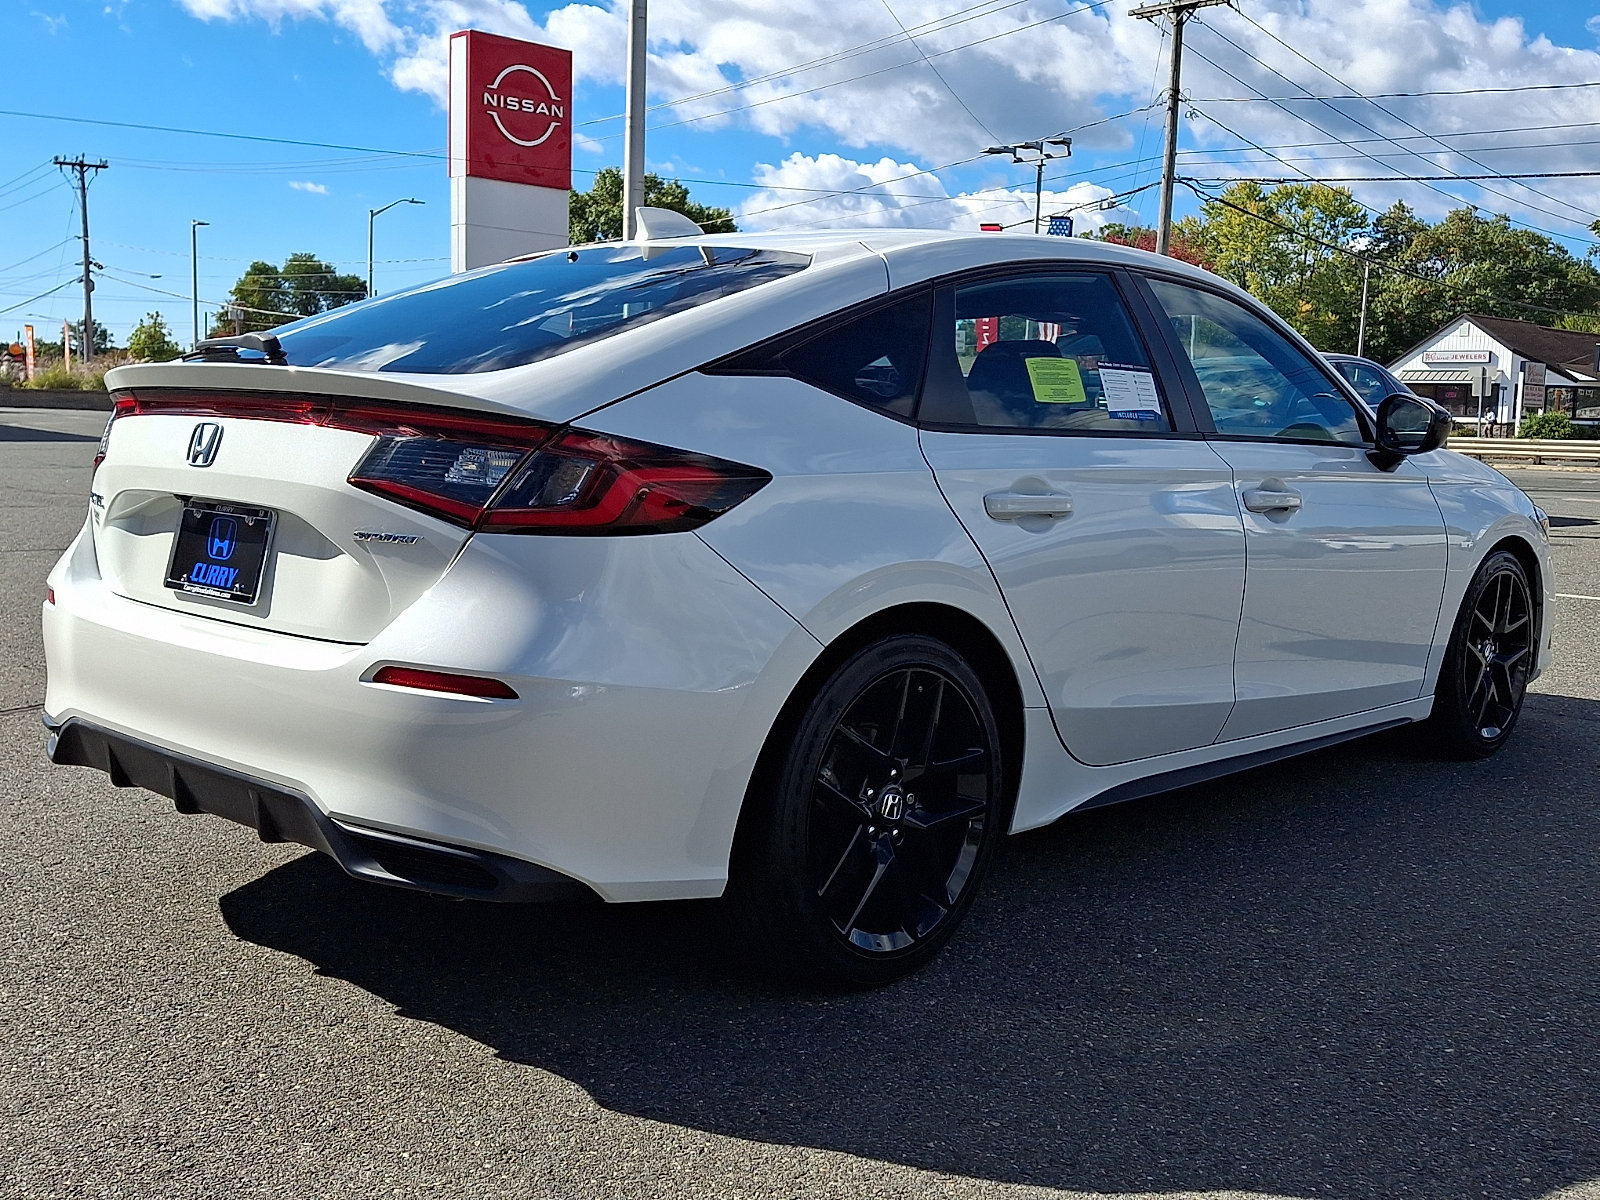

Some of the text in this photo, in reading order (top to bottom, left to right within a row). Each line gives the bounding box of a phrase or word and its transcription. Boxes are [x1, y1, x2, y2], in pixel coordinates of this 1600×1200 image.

[483, 92, 564, 118] NISSAN
[353, 529, 423, 545] SPORT
[190, 562, 239, 588] CURRY
